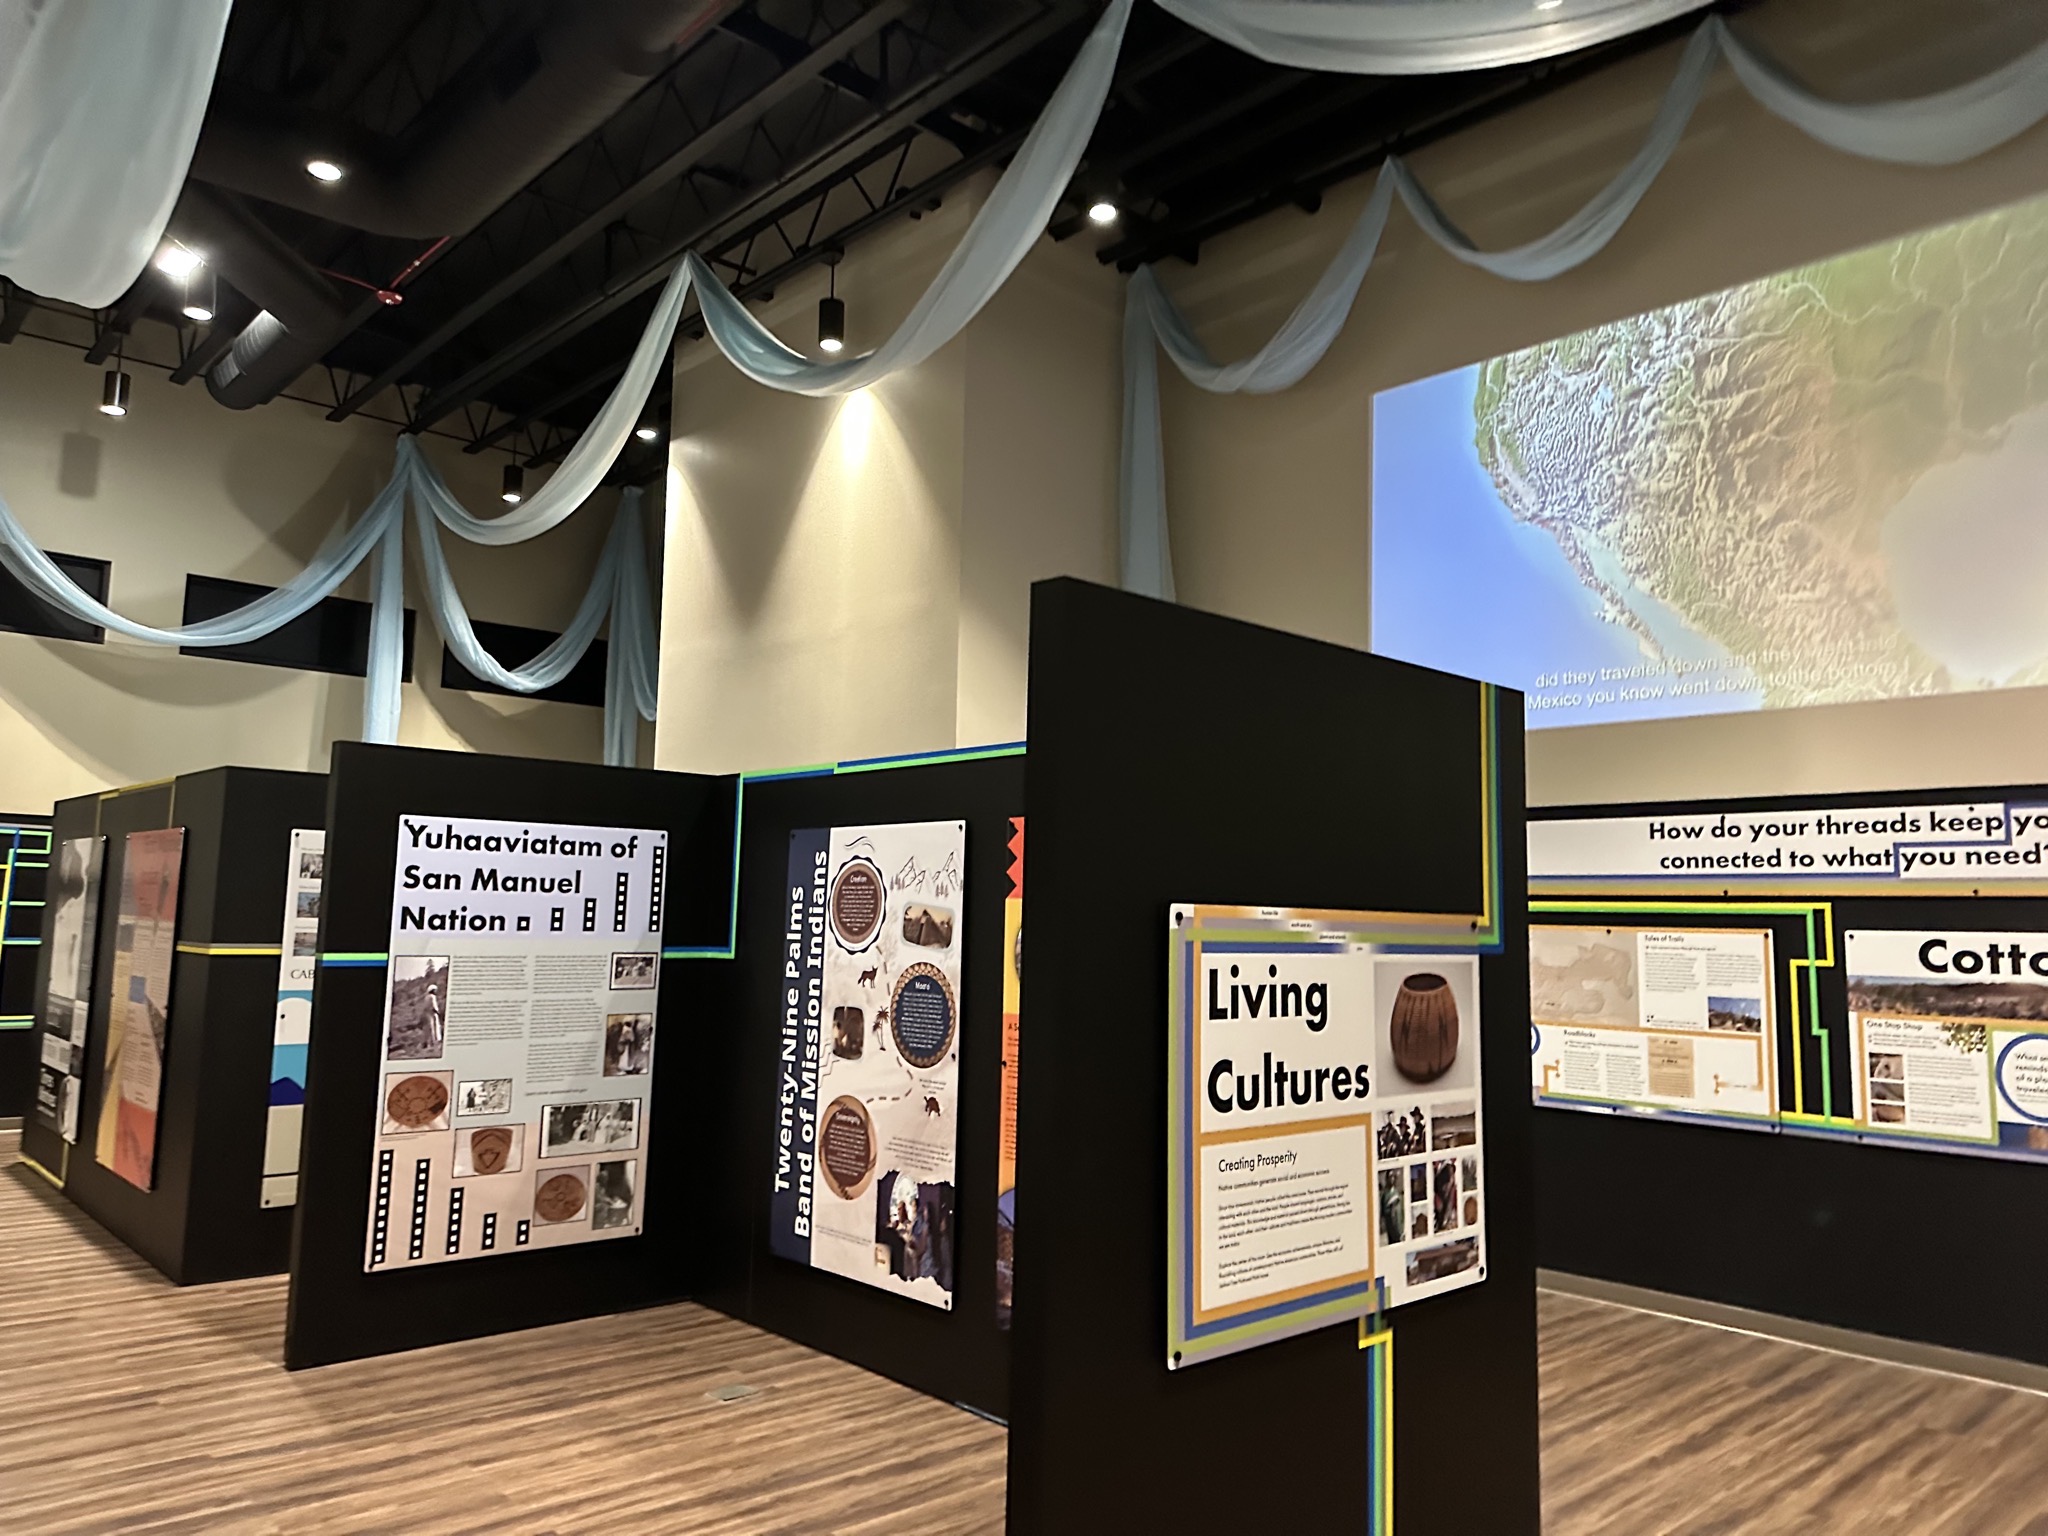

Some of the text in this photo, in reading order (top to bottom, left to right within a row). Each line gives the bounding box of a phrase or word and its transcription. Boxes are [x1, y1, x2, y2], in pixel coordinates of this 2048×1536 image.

[1535, 672, 1558, 688] did
[1563, 669, 1597, 685] they
[1601, 660, 1667, 681] traveled
[1671, 655, 1718, 673] down
[1726, 653, 1757, 667] and
[1528, 693, 1582, 710] Mexico
[1587, 691, 1615, 708] you
[1620, 686, 1665, 700] know
[1669, 680, 1710, 696] went
[405, 823, 638, 858] Yuhaaviatam of
[1650, 821, 1704, 840] How
[1711, 815, 1742, 838] do
[1749, 823, 1809, 843] your
[1816, 812, 1921, 835] threads
[1930, 811, 2003, 837] keep
[1660, 848, 1781, 869] connected
[1790, 851, 1815, 867] to
[1823, 846, 1893, 867] what
[1901, 852, 1955, 872] you
[403, 865, 582, 894] San Manuel
[400, 906, 506, 931] Nation
[1209, 964, 1328, 1032] Living
[775, 887, 804, 1192] Twenty-Nine Palms
[1867, 1020, 1882, 1028] One
[794, 851, 827, 1238] Band of Mission Indians
[1207, 1052, 1370, 1113] Cultures
[1219, 1150, 1298, 1172] Creating Prosperity
